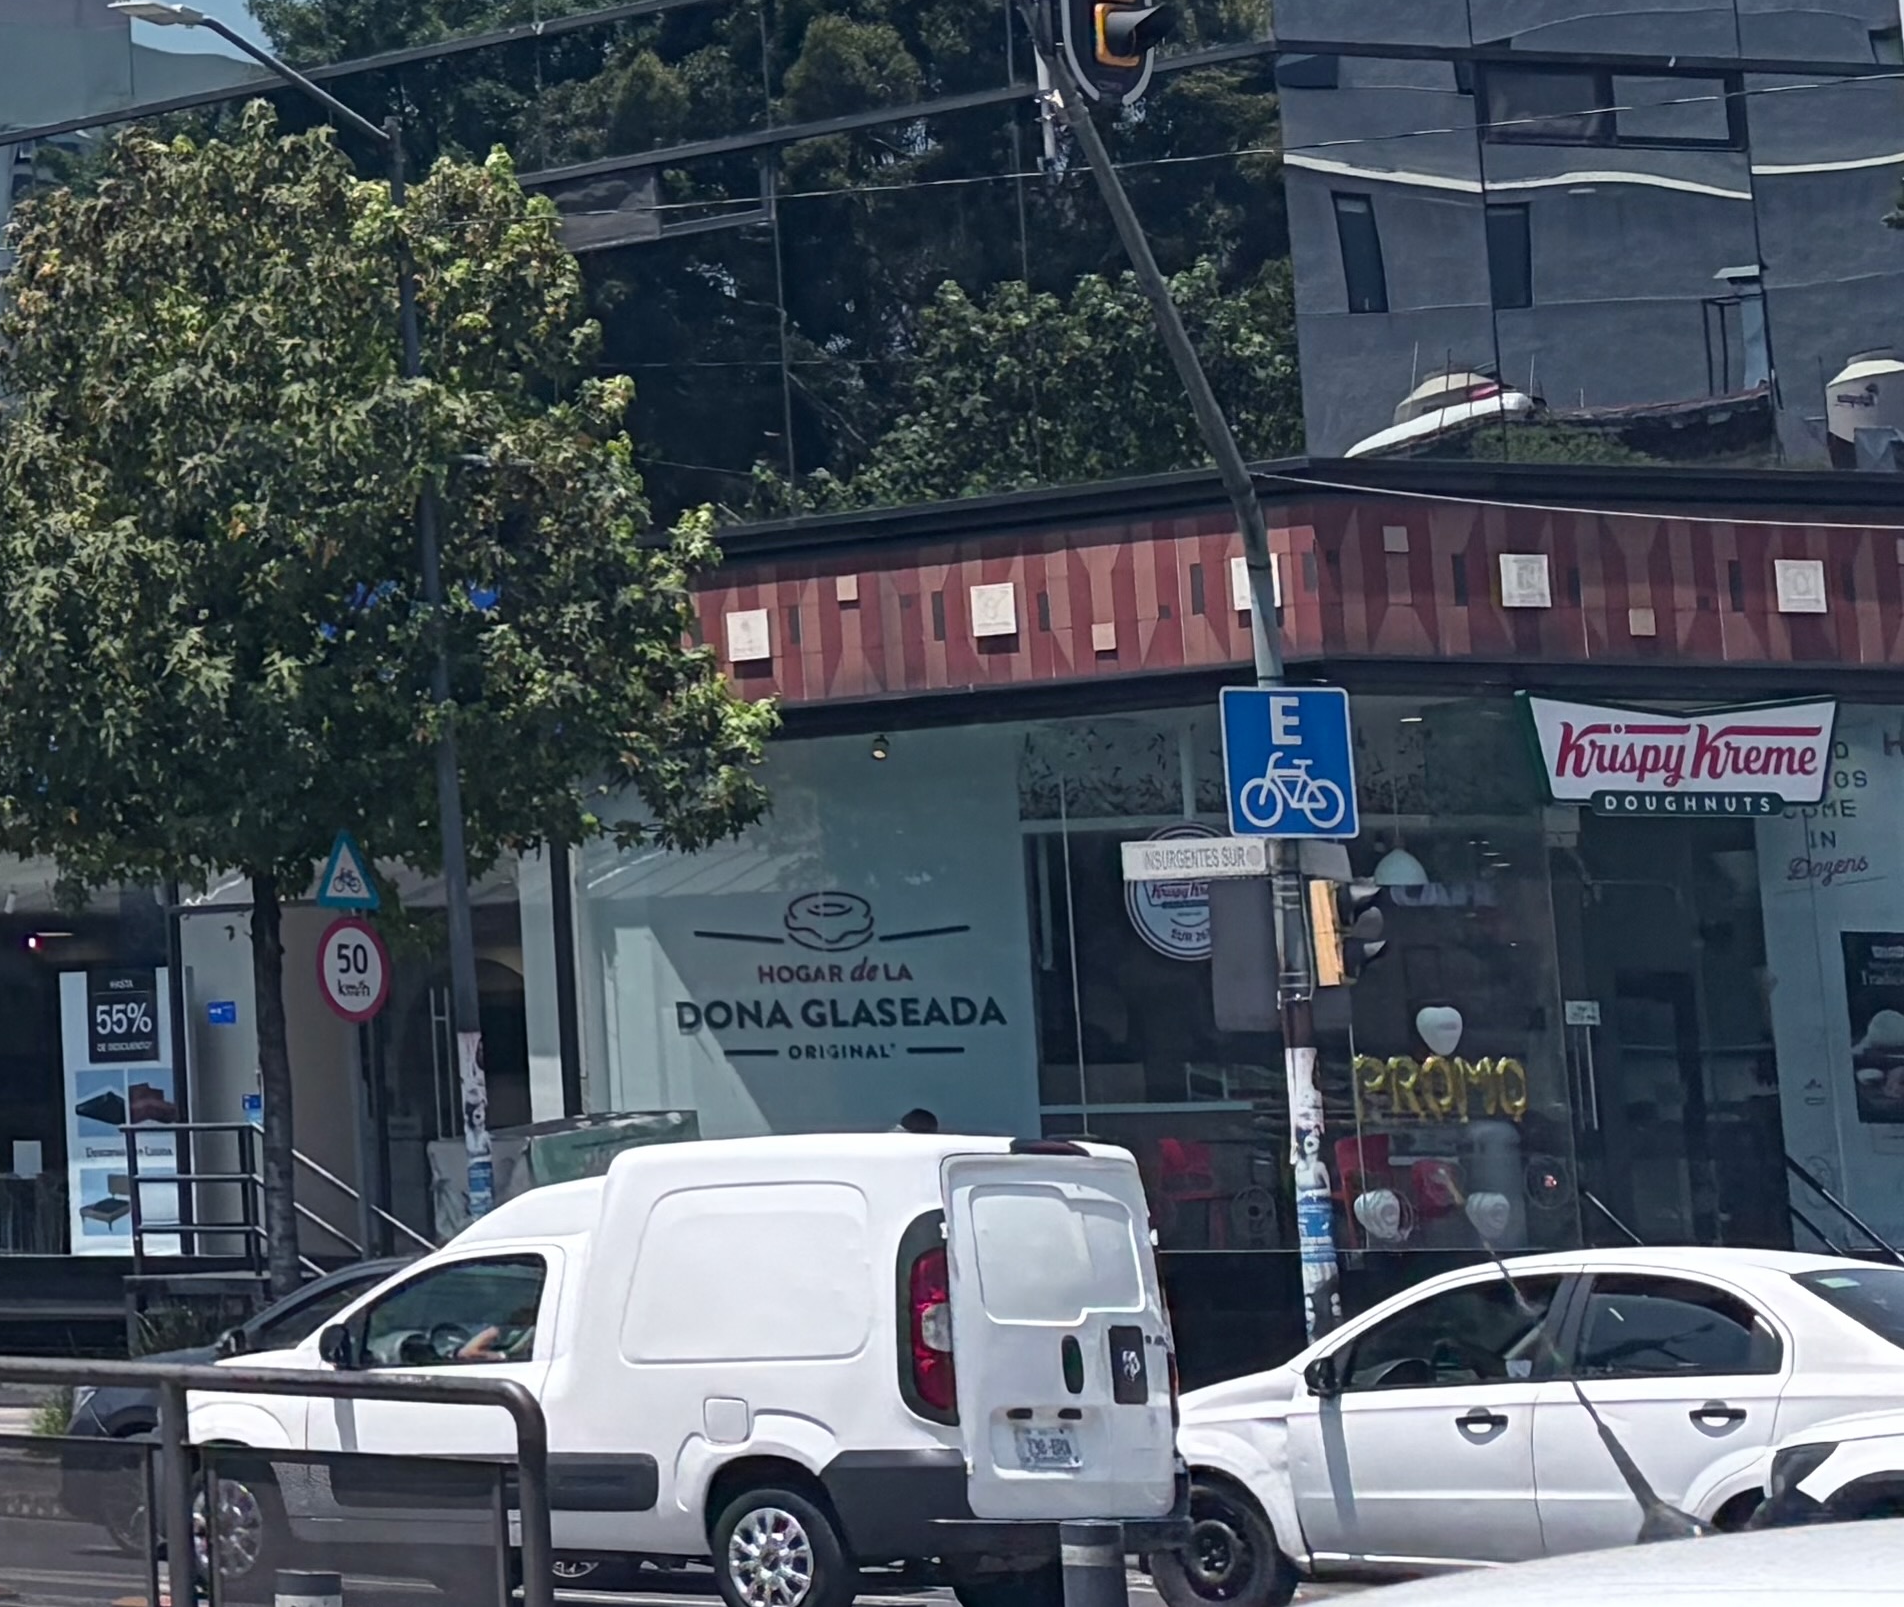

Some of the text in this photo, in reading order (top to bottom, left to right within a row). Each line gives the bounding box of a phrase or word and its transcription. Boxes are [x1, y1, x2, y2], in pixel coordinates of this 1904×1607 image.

[1269, 696, 1302, 746] E
[1555, 721, 1823, 787] Krispy Kreme
[1604, 795, 1771, 813] DOUGHNUTS
[1810, 831, 1837, 849] IN
[1144, 846, 1247, 871] INSURGENTES SUR
[1786, 854, 1870, 886] Dozens
[336, 943, 369, 975] 50
[758, 955, 914, 985] HOGAR de LA
[96, 1002, 153, 1035] 55%
[675, 995, 1008, 1036] DONA GLASEADA
[788, 1043, 891, 1060] ORIGINAL
[1352, 1053, 1528, 1124] PROMO
